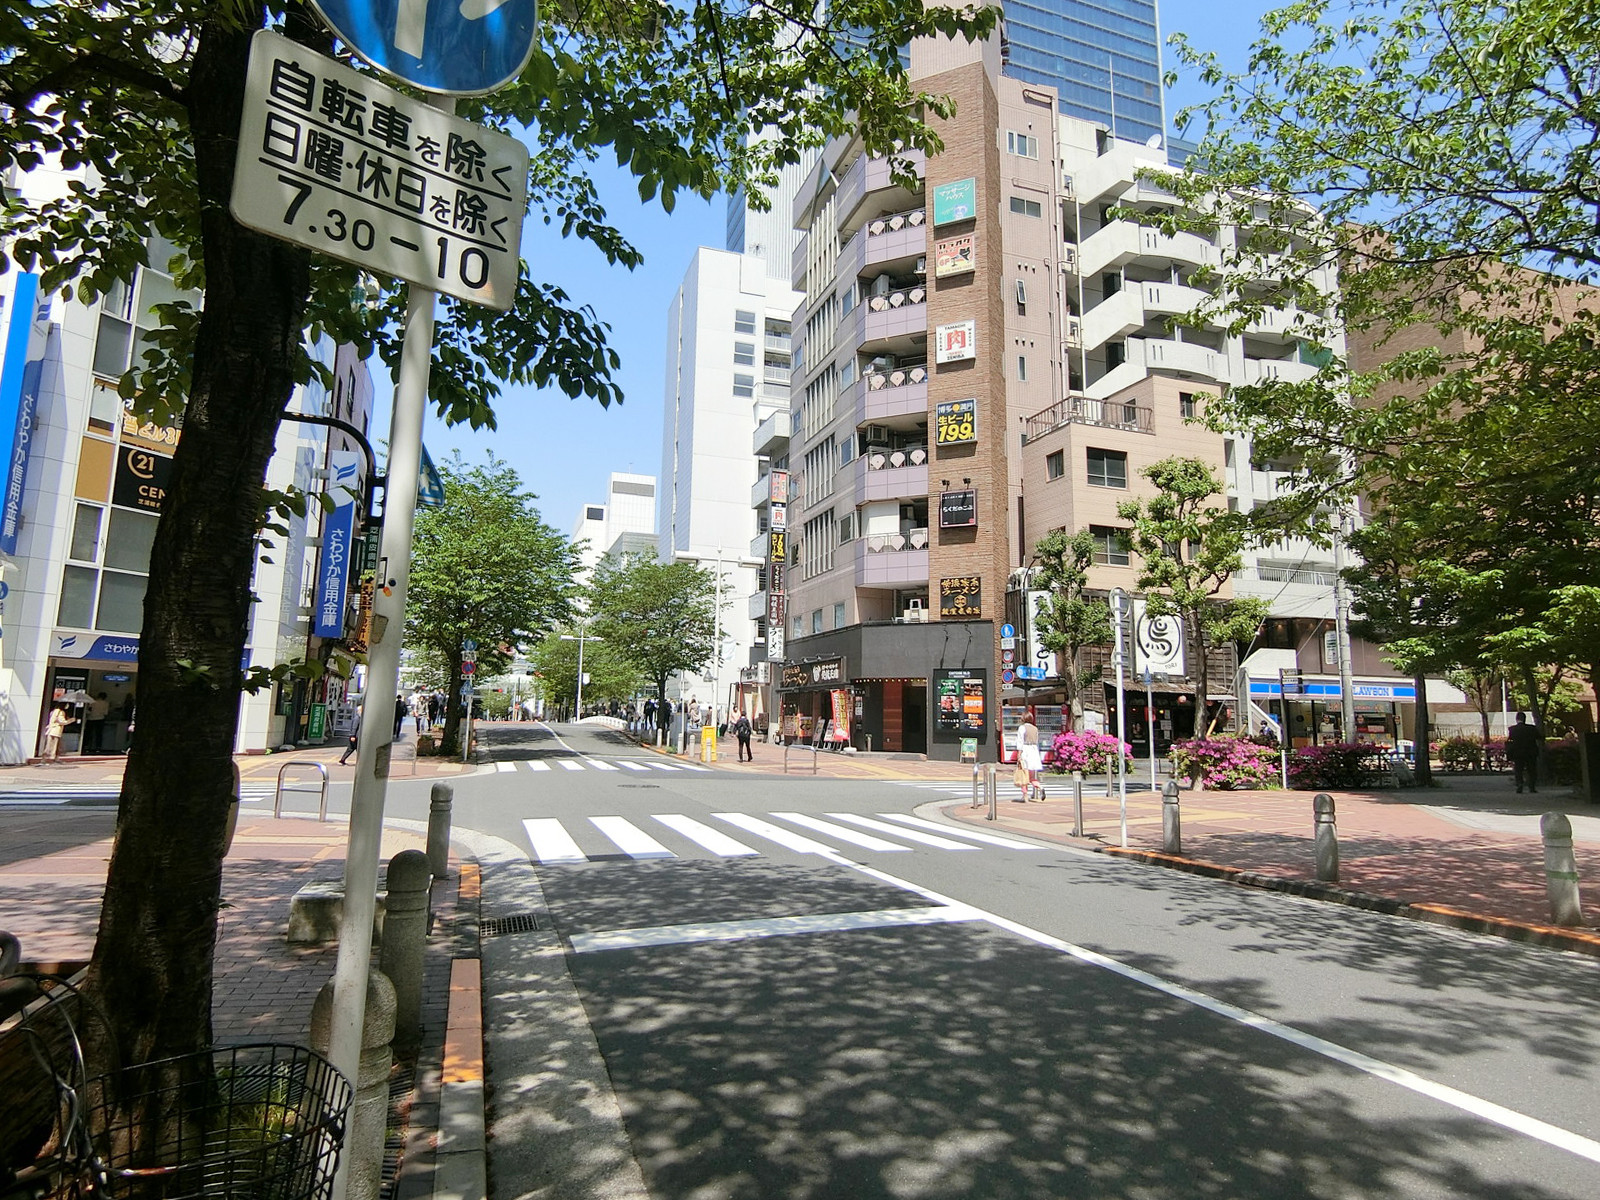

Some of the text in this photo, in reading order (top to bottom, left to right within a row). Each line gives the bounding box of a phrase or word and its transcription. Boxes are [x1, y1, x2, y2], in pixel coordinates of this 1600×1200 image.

[269, 59, 513, 193] 自転車を除く
[262, 112, 509, 245] 日曜・休日を除く
[938, 184, 971, 197] マッサージ
[945, 329, 966, 351] 肉
[938, 413, 974, 426] 生ビール
[3, 394, 34, 538] さわやか信用金庫
[321, 528, 345, 628] さわやか信用金庫
[941, 586, 980, 597] ラーメン
[769, 627, 778, 657] ラーメン
[1353, 686, 1390, 696] LAWSON
